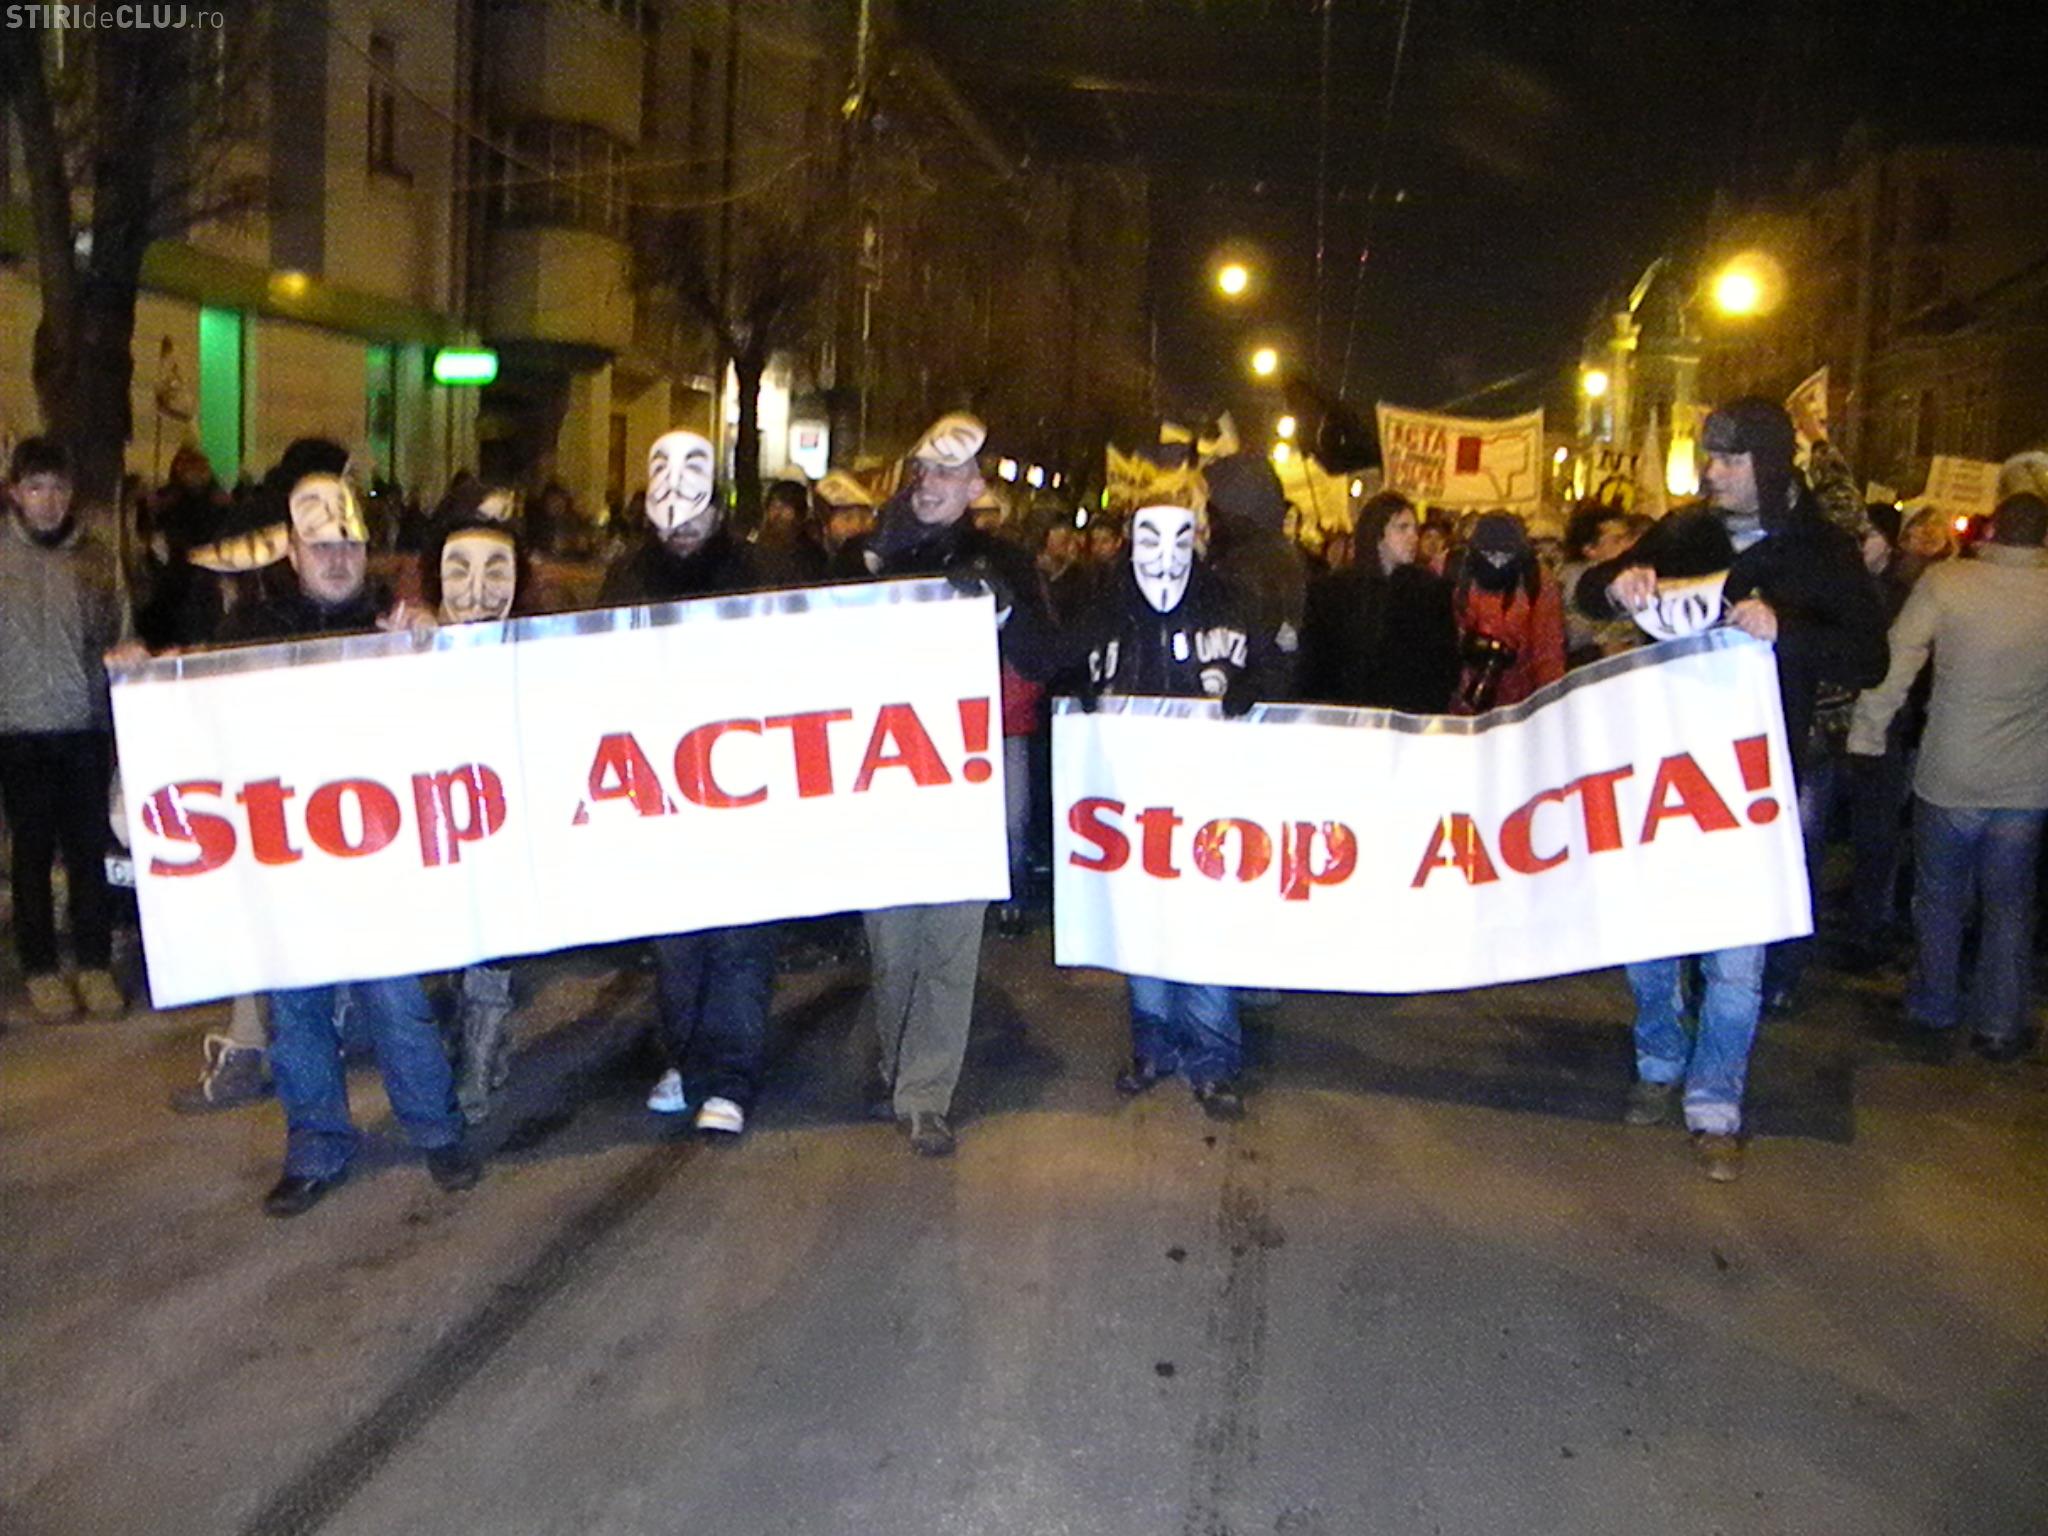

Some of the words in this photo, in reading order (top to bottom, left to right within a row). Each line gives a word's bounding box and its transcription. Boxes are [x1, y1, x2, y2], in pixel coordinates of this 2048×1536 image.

[141, 763, 507, 878] Stop
[572, 696, 994, 827] ACTA!
[1066, 797, 1359, 901] Stop
[1411, 733, 1781, 888] ACTA!
